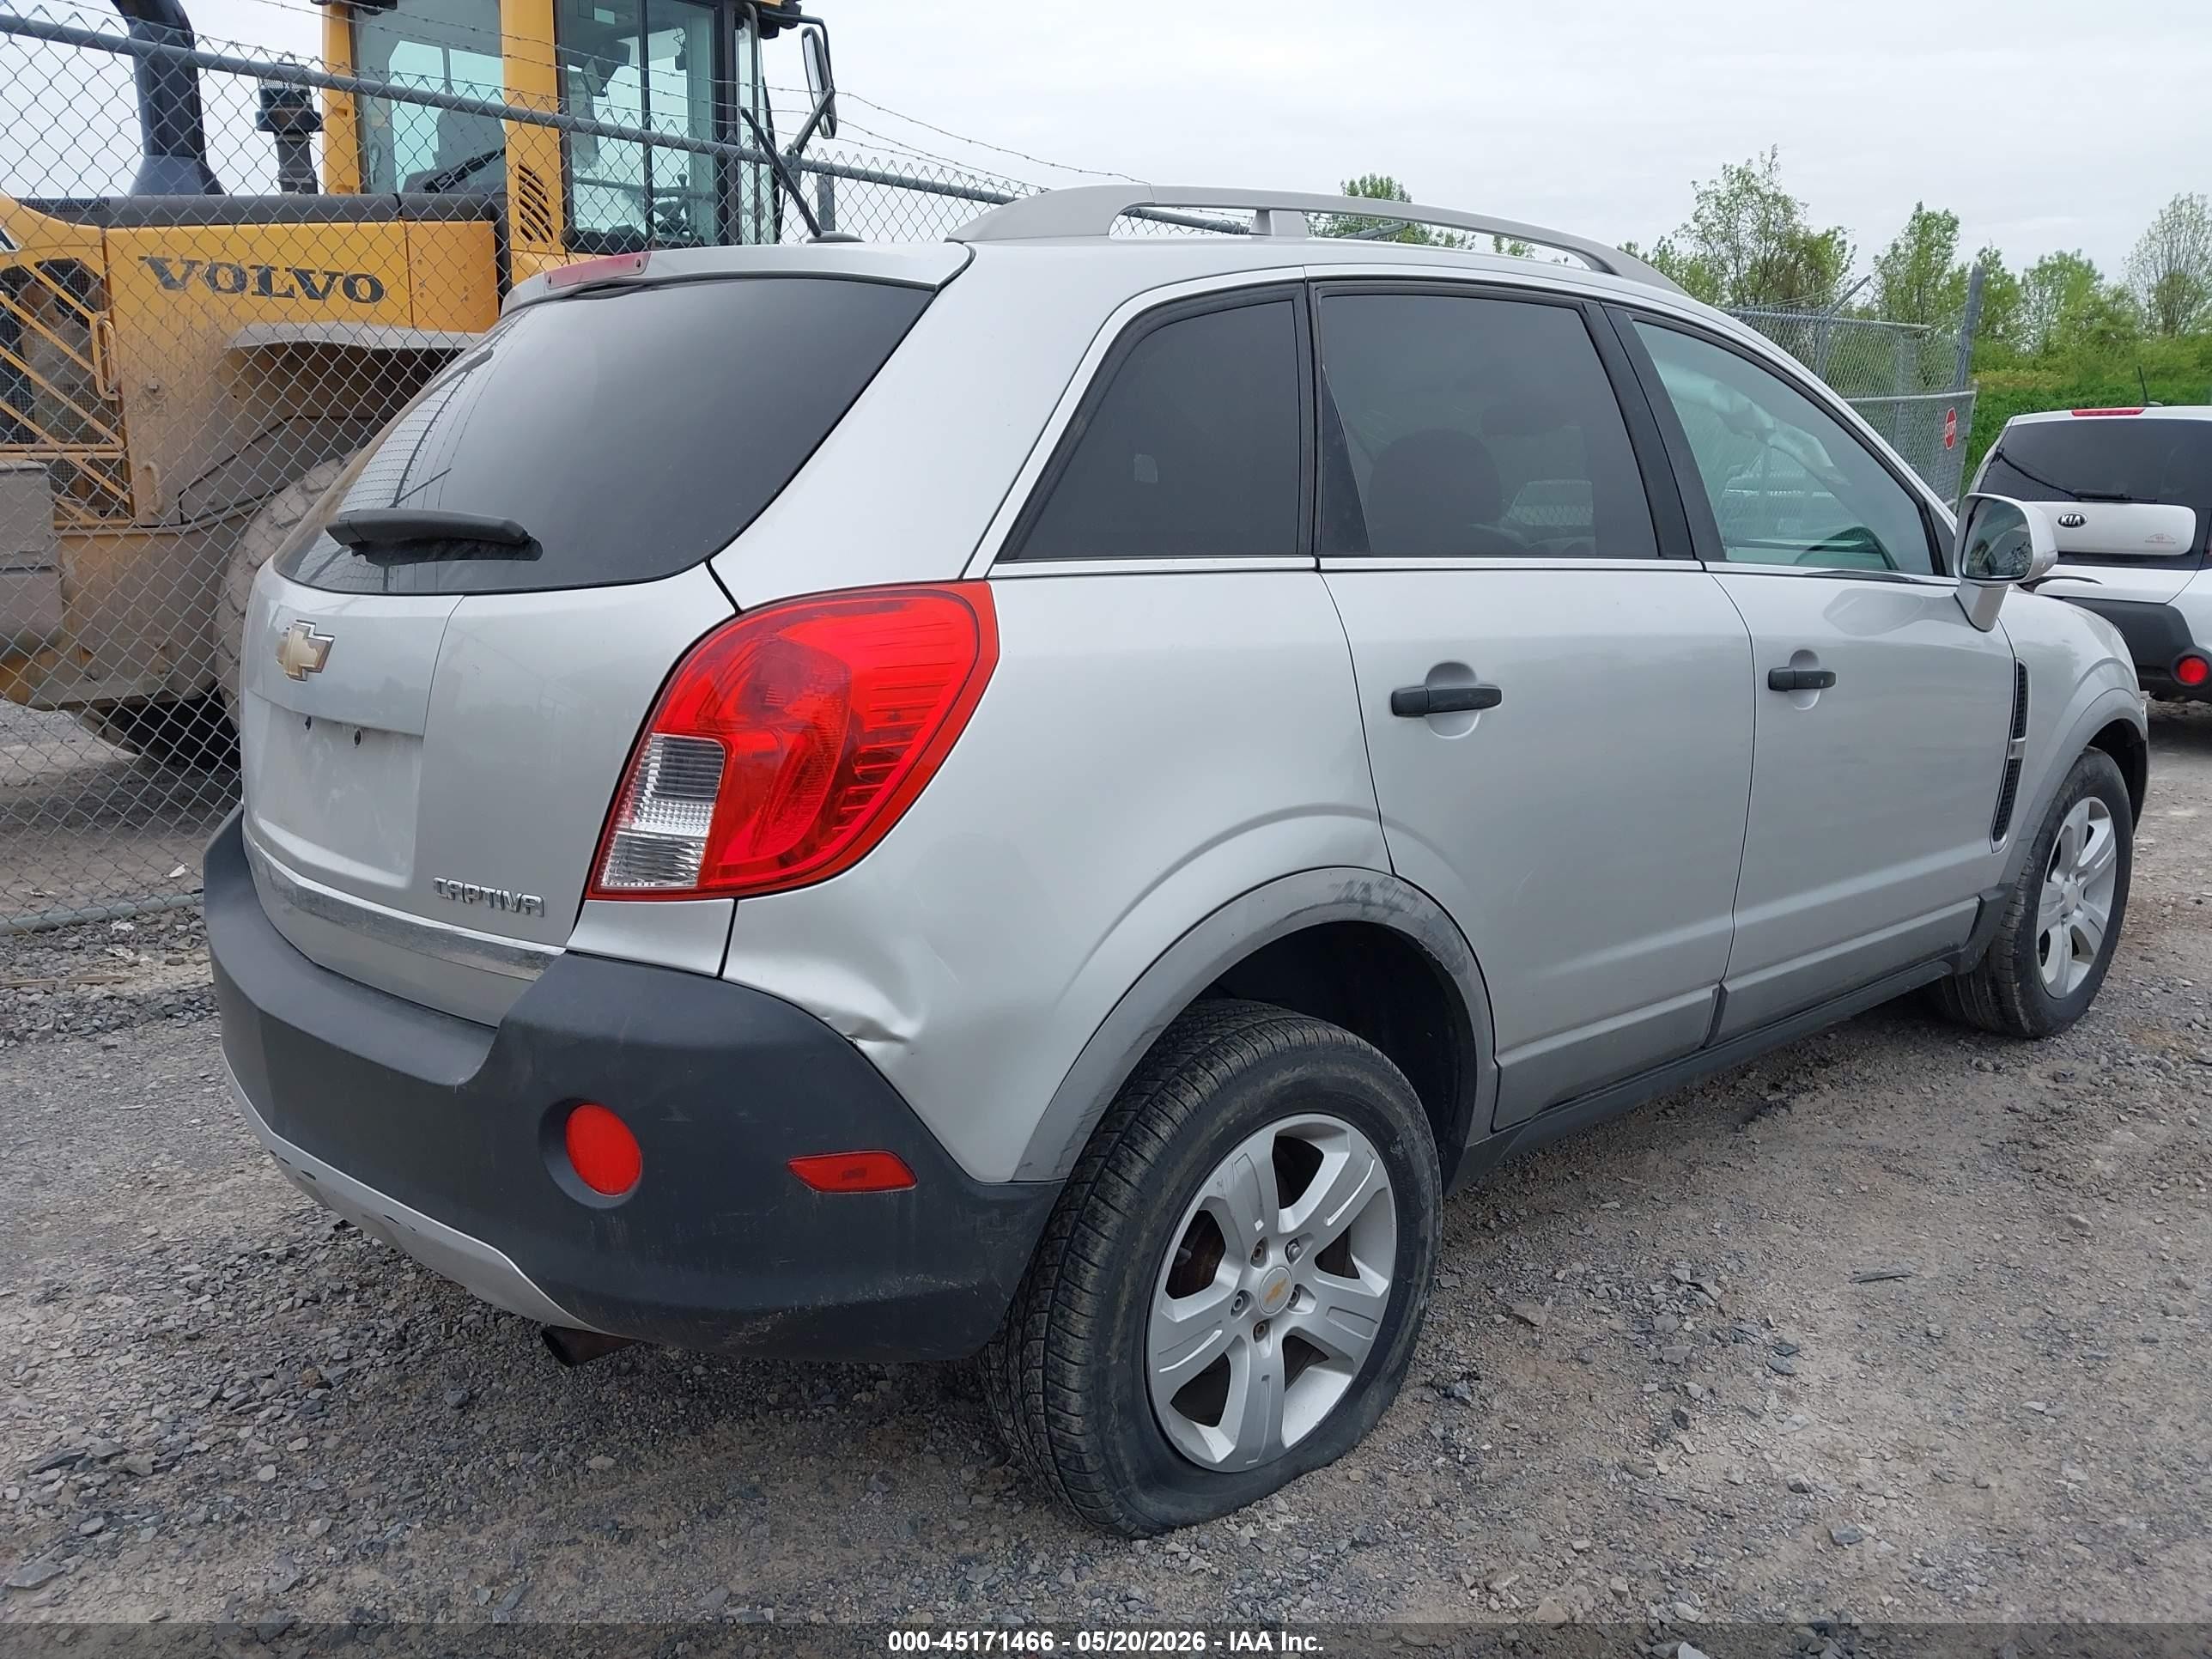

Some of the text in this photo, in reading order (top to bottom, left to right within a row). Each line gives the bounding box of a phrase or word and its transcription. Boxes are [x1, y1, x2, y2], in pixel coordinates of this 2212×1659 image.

[137, 255, 386, 303] VOLVO
[2061, 514, 2081, 525] KIA
[433, 877, 544, 917] CAPTIVA
